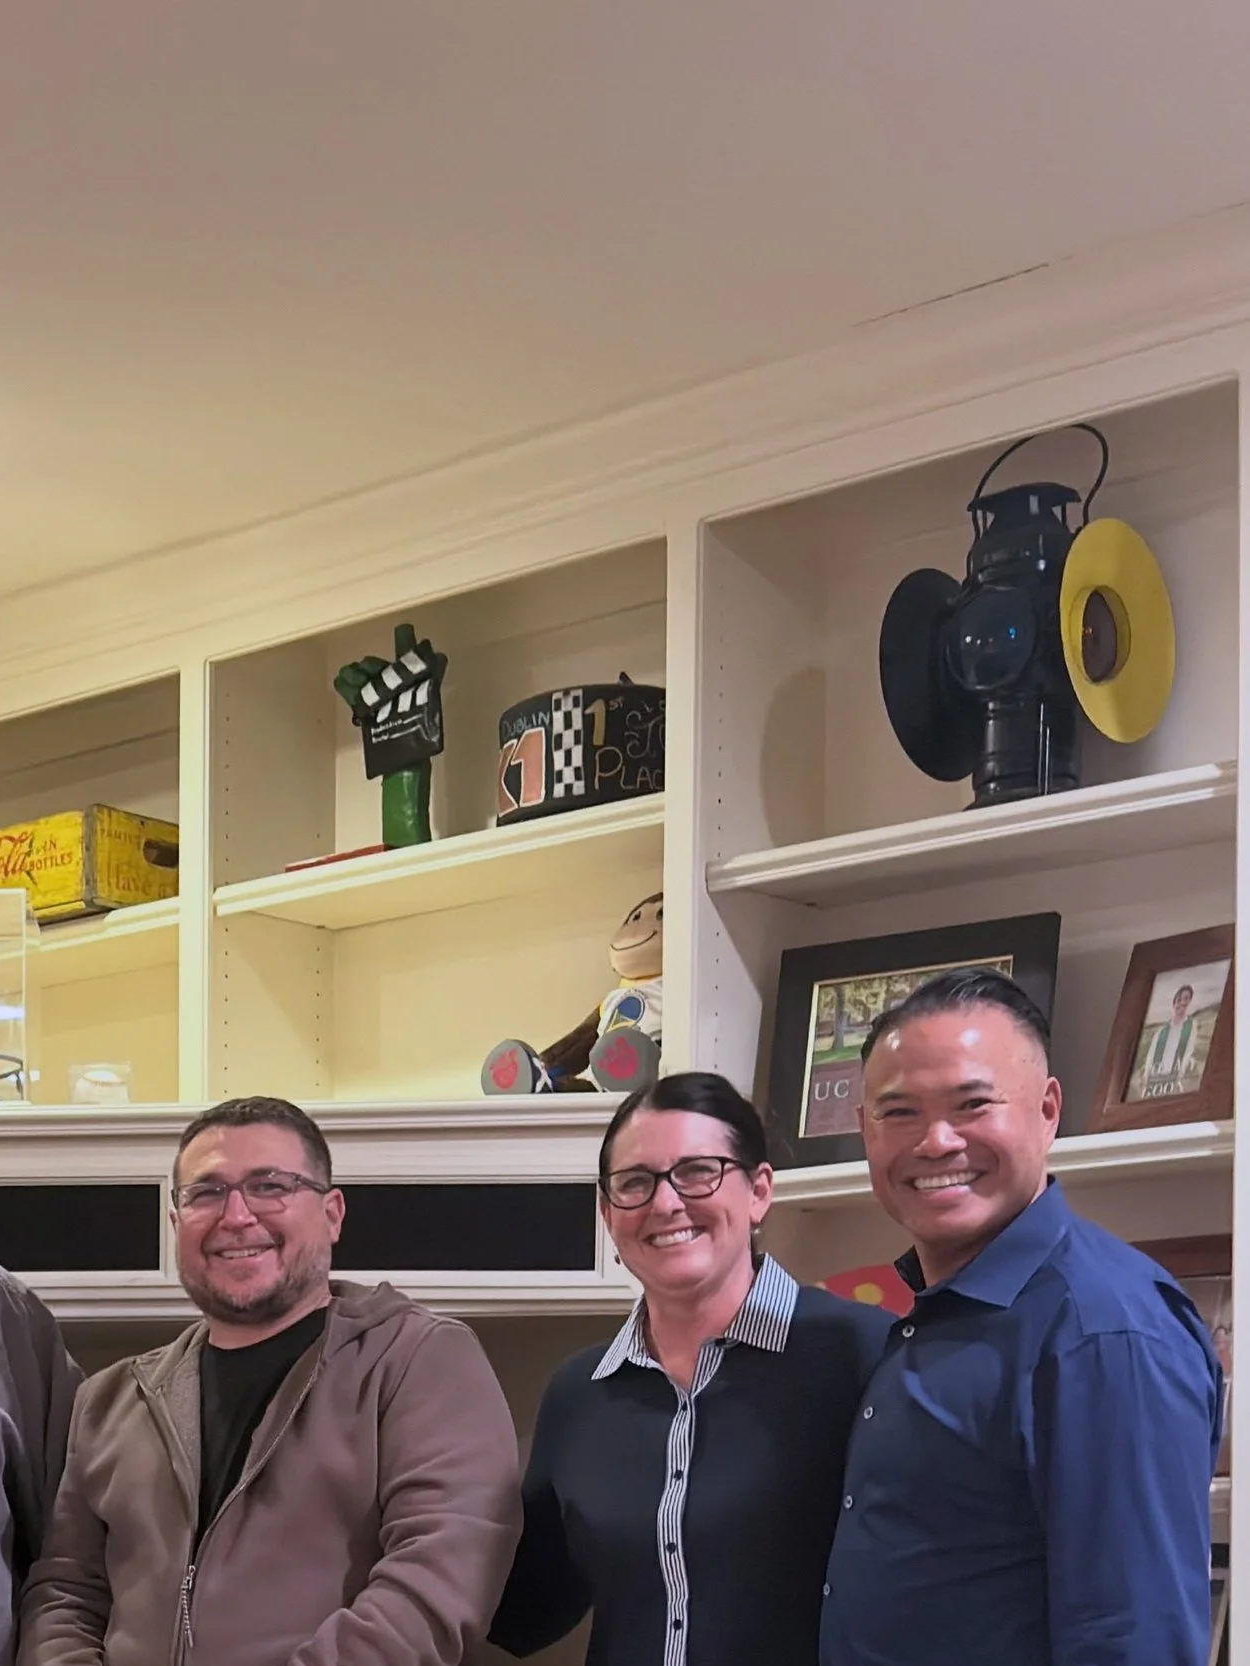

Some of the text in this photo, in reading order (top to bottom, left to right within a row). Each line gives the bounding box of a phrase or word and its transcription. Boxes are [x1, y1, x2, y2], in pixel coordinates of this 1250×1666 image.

[44, 839, 58, 853] IN
[30, 851, 73, 872] BOTTLES
[814, 1079, 851, 1102] UC
